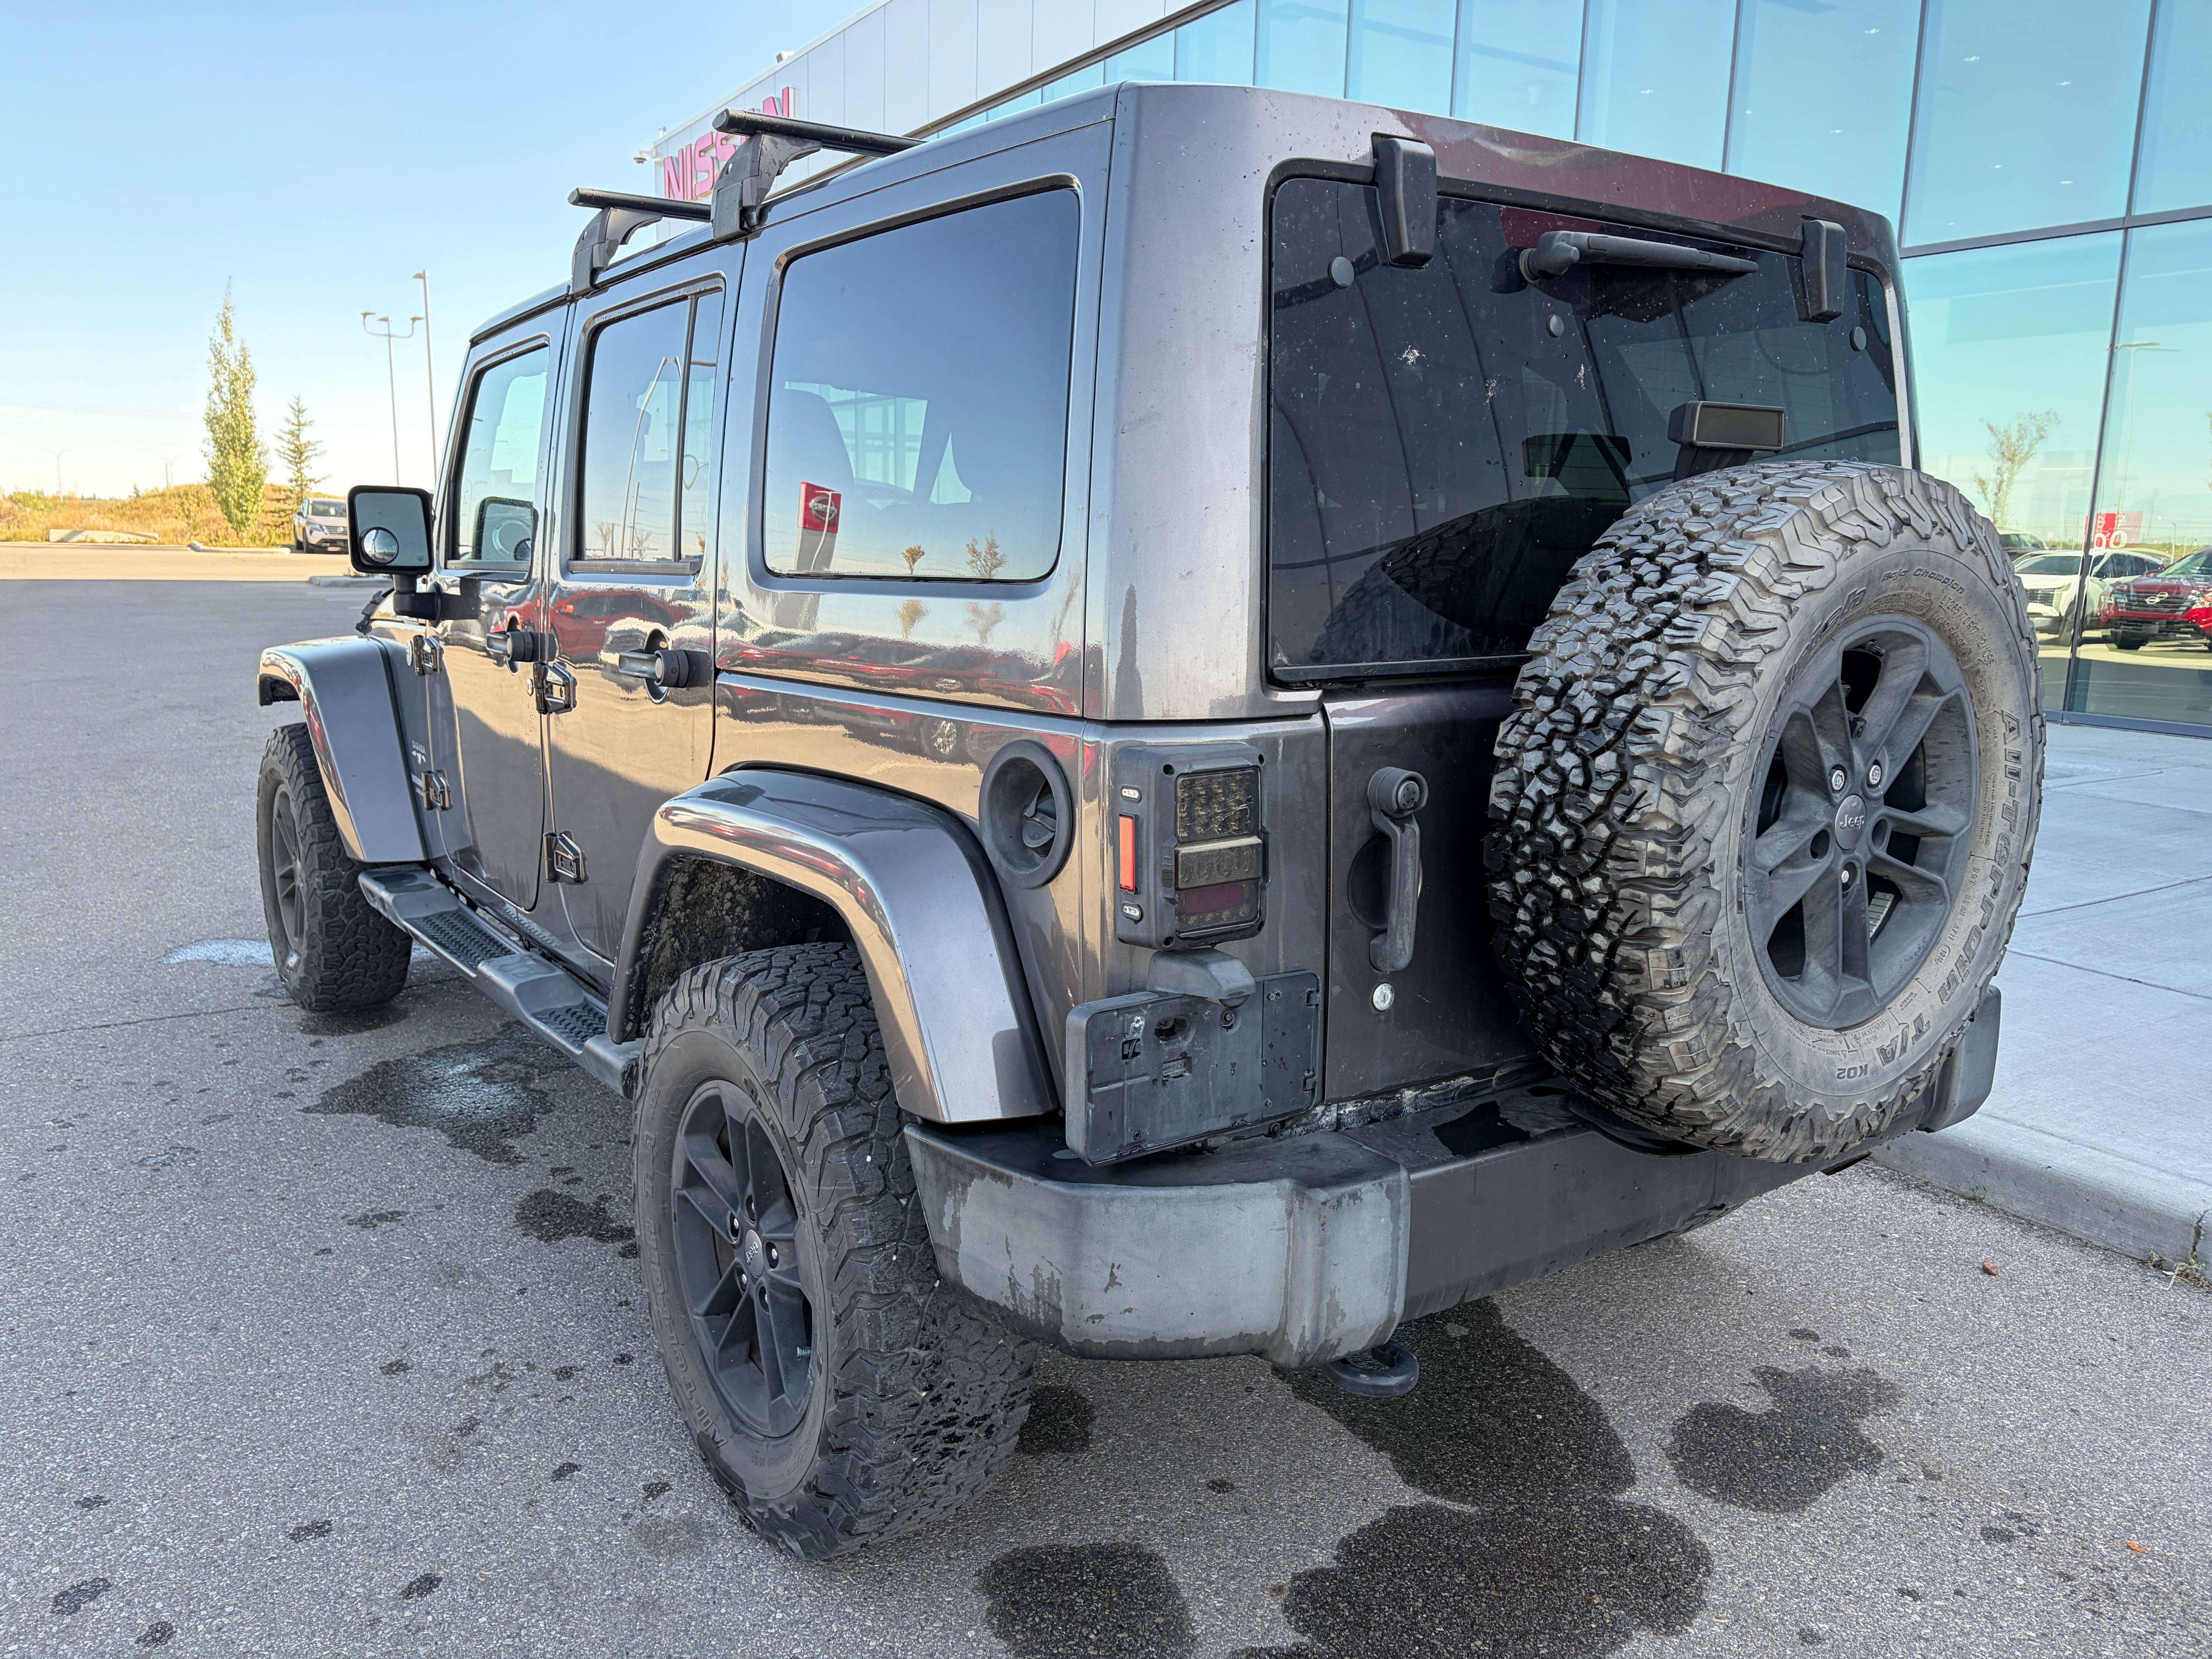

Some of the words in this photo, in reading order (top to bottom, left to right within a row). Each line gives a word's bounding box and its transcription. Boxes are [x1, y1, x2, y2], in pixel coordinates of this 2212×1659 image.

[1881, 568, 1908, 582] Baja
[1913, 567, 1965, 594] Champion
[1933, 613, 1949, 629] LOAD
[1948, 627, 1966, 648] RANGE
[1840, 815, 1865, 830] Jeep
[1937, 709, 2021, 1005] All-Terrain
[1970, 867, 1980, 886] DOT
[1876, 1013, 1931, 1066] T/A
[1836, 1064, 1868, 1080] KO2
[746, 1241, 759, 1265] Jeep
